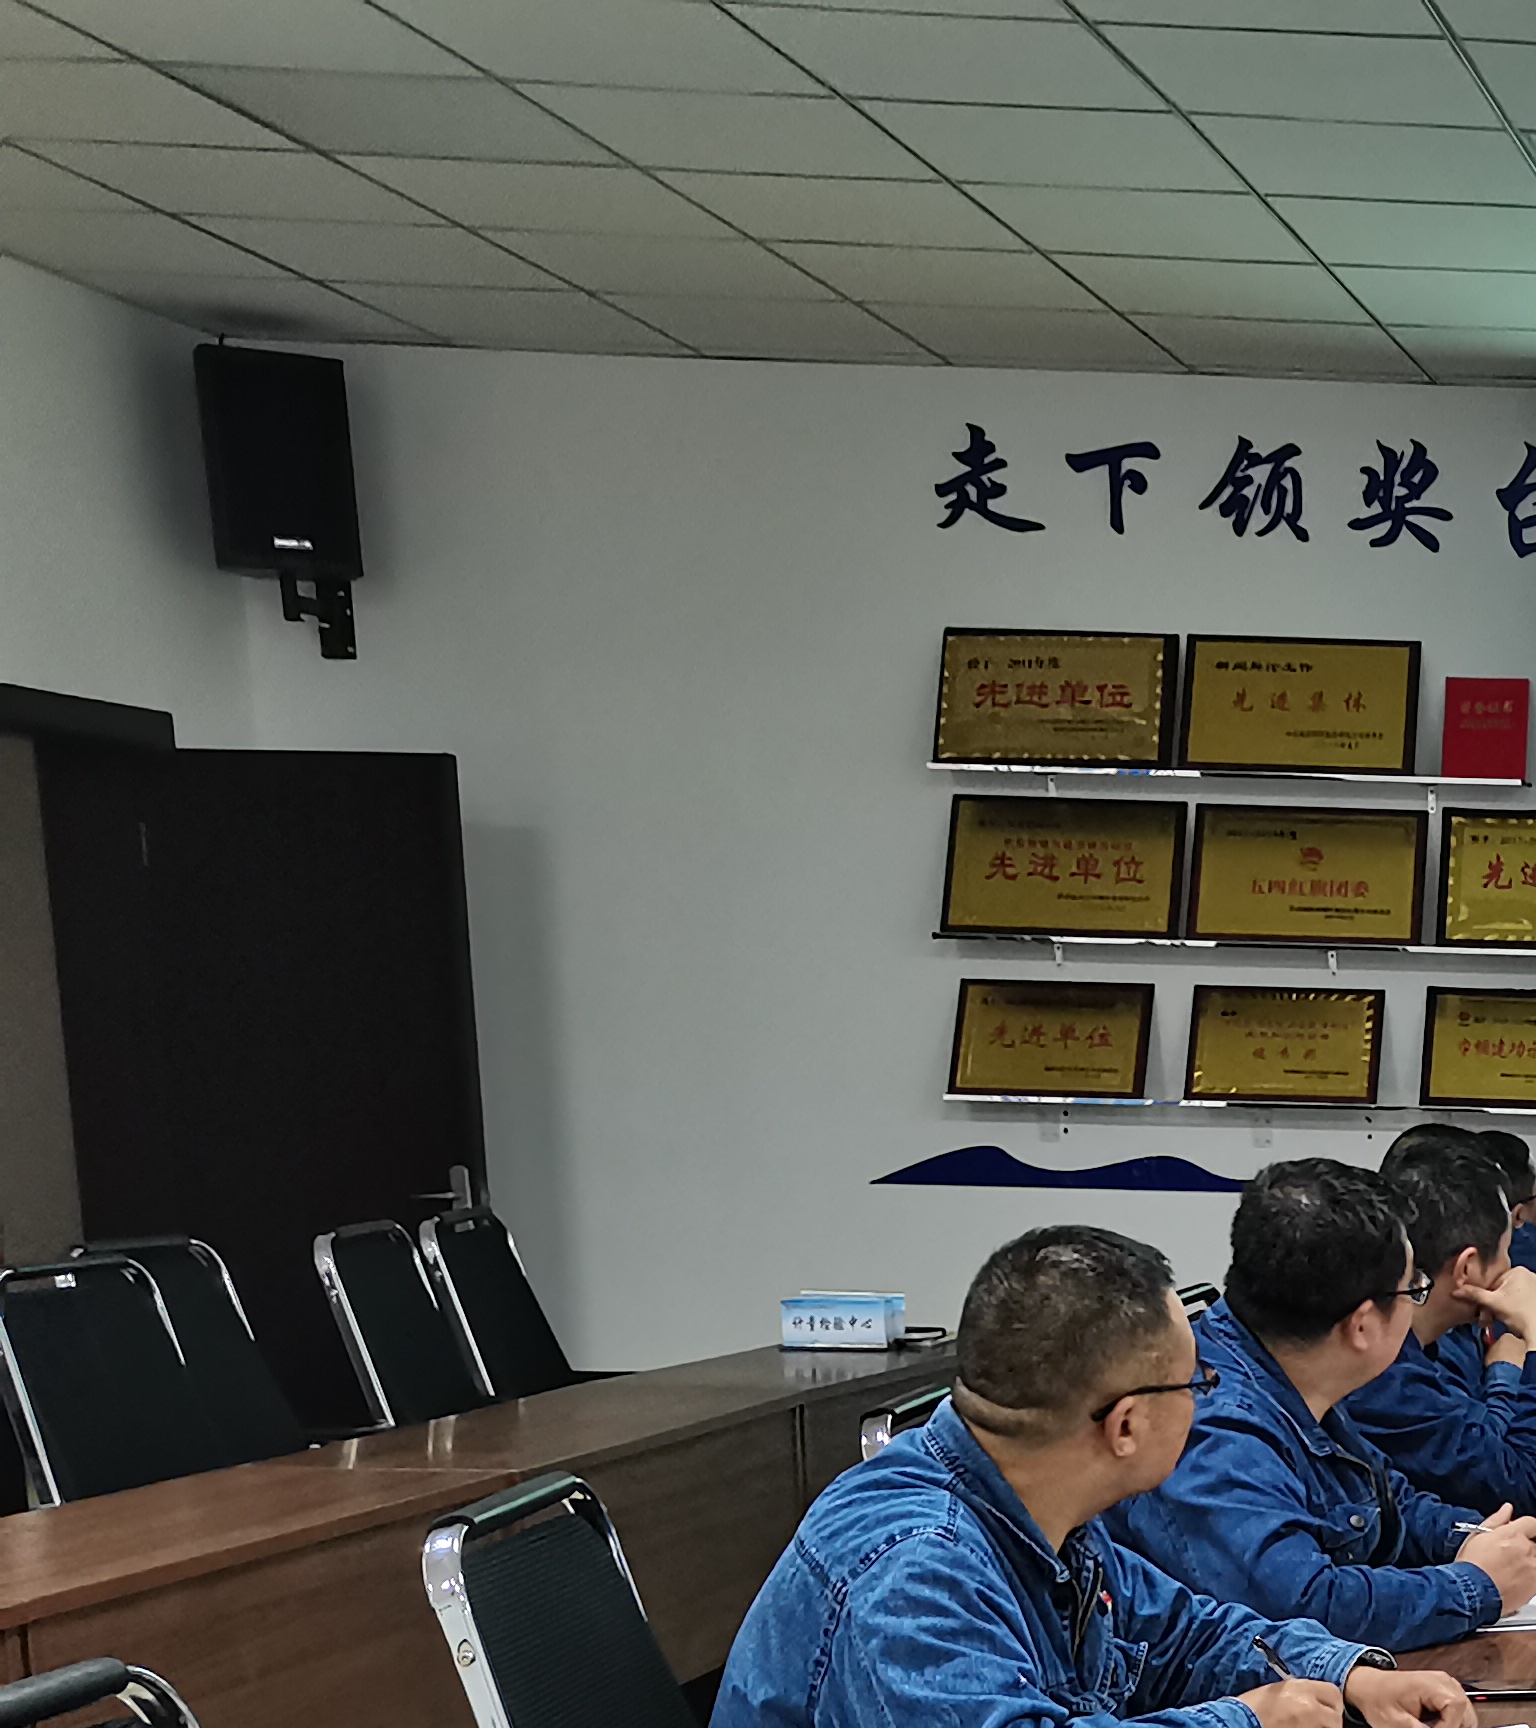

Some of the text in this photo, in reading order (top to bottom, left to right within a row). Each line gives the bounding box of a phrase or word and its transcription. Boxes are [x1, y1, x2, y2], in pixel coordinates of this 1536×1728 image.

[972, 679, 1134, 710] 先进单位
[984, 851, 1146, 885] 先进单位
[988, 1019, 1114, 1050] 先进单位
